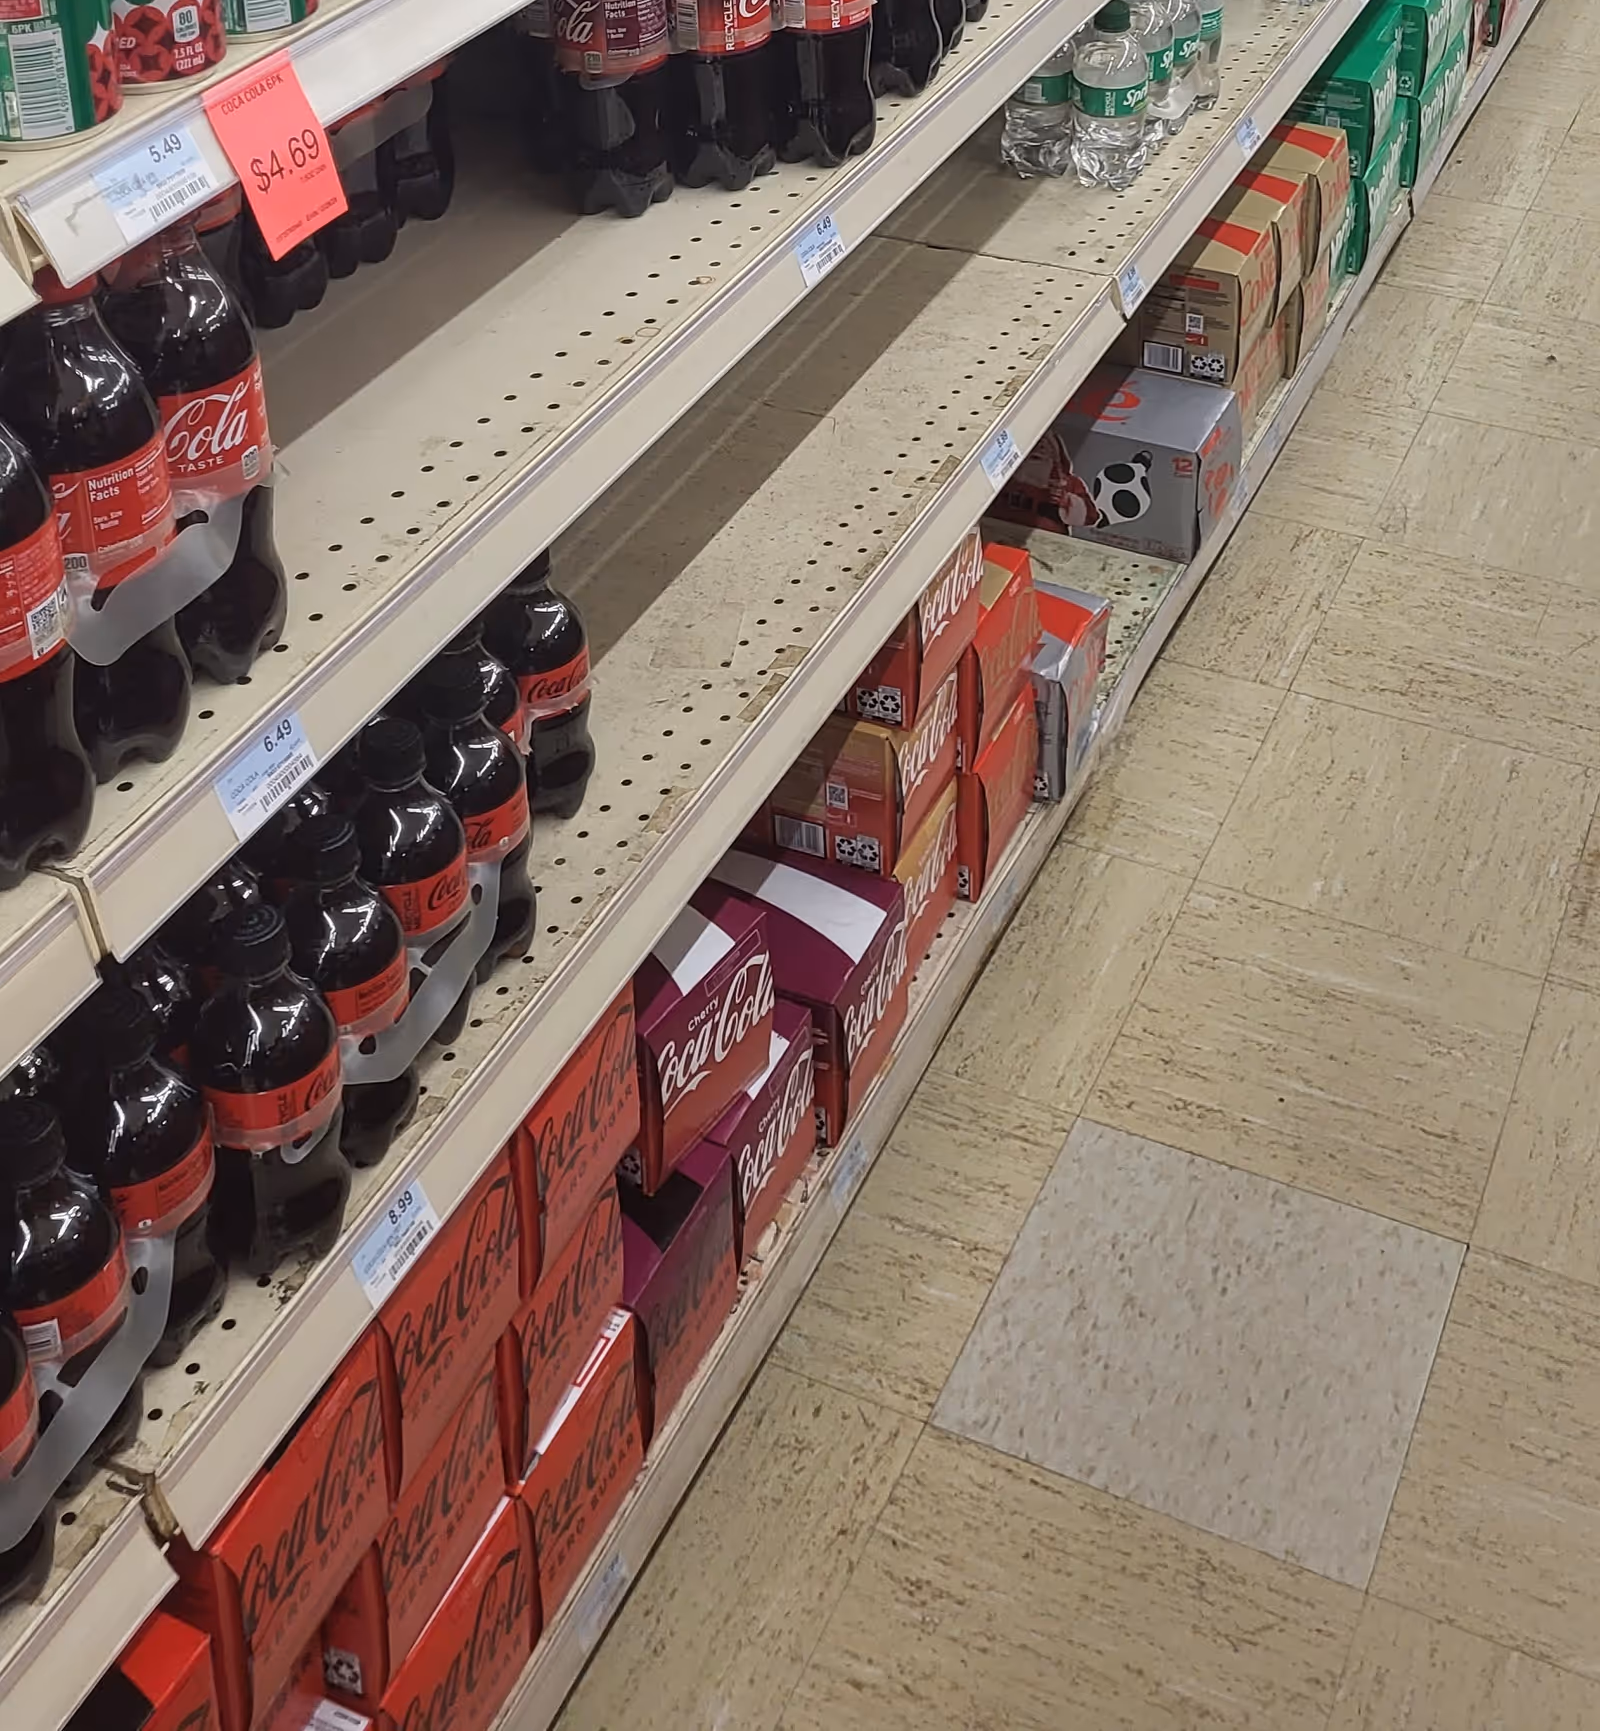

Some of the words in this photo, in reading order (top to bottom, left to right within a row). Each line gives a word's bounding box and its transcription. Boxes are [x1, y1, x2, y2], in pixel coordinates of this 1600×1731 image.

[178, 9, 194, 25] 80
[604, 0, 637, 11] Nutrition
[605, 9, 626, 18] Facts
[11, 22, 33, 34] 6PK
[722, 0, 735, 52] RECYCLE
[220, 95, 245, 116] COCA
[245, 84, 267, 104] COLA
[266, 73, 284, 91] 6PK
[148, 132, 183, 164] 5.49
[250, 128, 321, 194] $4.69
[816, 215, 833, 237] 6.49
[87, 466, 135, 492] Nutrition
[177, 455, 225, 474] TASTE
[89, 484, 121, 503] Facts
[64, 555, 88, 570] 200
[263, 719, 293, 753] 6.49
[686, 995, 720, 1032] Cherry
[656, 950, 776, 1120] Coca-Cola
[537, 1003, 637, 1184] Coca-Cola
[738, 1047, 816, 1217] Coca-Cola
[758, 1095, 780, 1133] Cherry
[388, 1189, 413, 1225] 8.99
[394, 1175, 520, 1390] Coca-Cola
[520, 1187, 624, 1381] Coca-Cola
[533, 1358, 637, 1556] Coca-Cola
[380, 1374, 497, 1594] Coca-Cola
[239, 1378, 383, 1644] Coca-Cola
